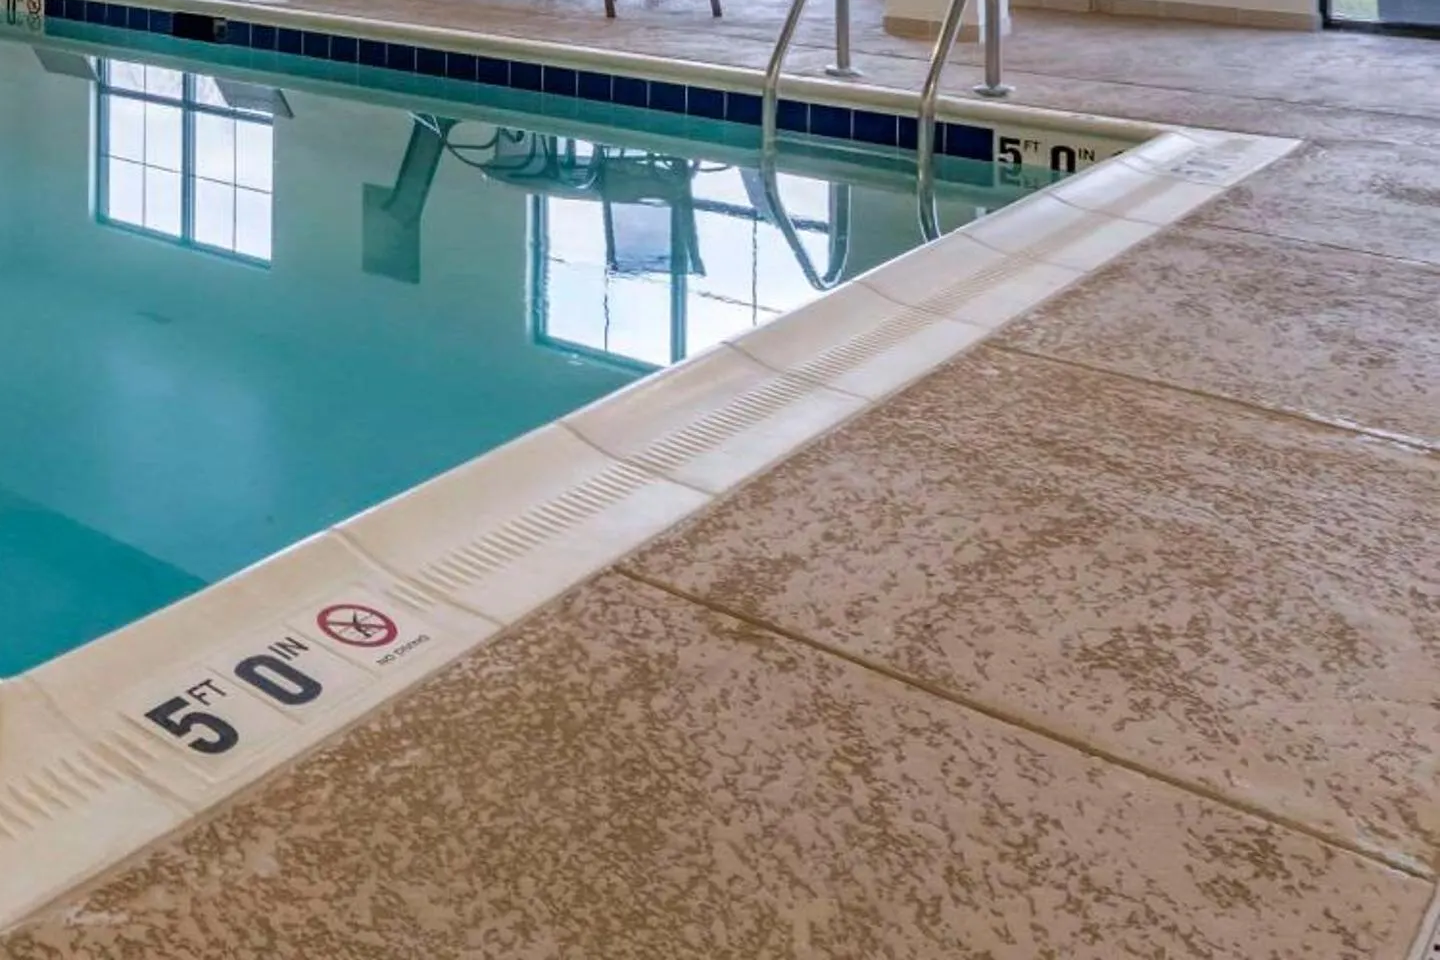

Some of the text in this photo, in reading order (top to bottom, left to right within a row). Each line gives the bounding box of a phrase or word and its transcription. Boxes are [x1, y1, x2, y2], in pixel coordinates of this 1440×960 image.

[1024, 140, 1040, 152] FT
[1079, 148, 1095, 161] IN
[144, 637, 323, 755] 5 FT 0 IN
